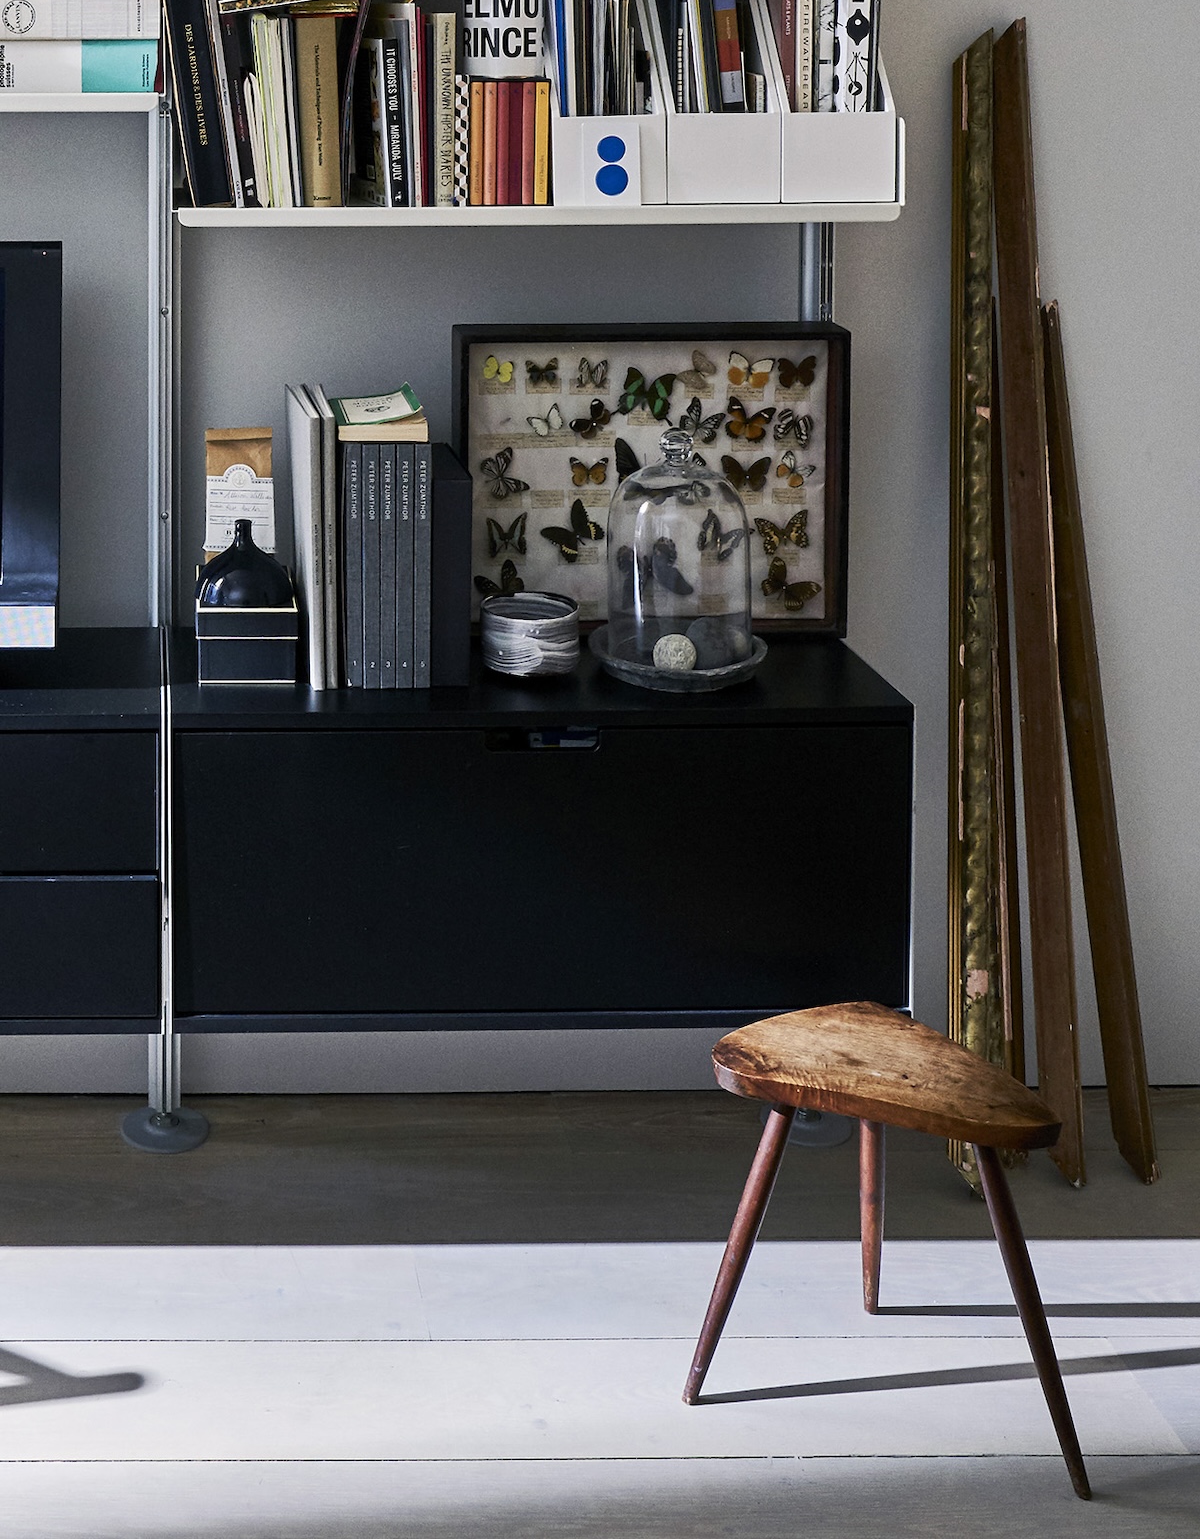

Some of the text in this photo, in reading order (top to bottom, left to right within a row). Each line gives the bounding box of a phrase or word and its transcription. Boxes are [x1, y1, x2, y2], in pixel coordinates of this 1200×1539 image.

[184, 24, 194, 43] DES
[187, 44, 200, 85] JARDINS
[440, 48, 452, 65] THE
[194, 92, 203, 112] DES
[441, 67, 453, 110] UNKNOWN
[195, 113, 208, 146] LIVRES
[386, 48, 402, 181] IT CHOOSES YOU MIRANDA JULY
[441, 114, 453, 146] HIPSTER
[440, 149, 453, 187] DIARIES
[368, 461, 376, 520] PETER ZUMTHOR
